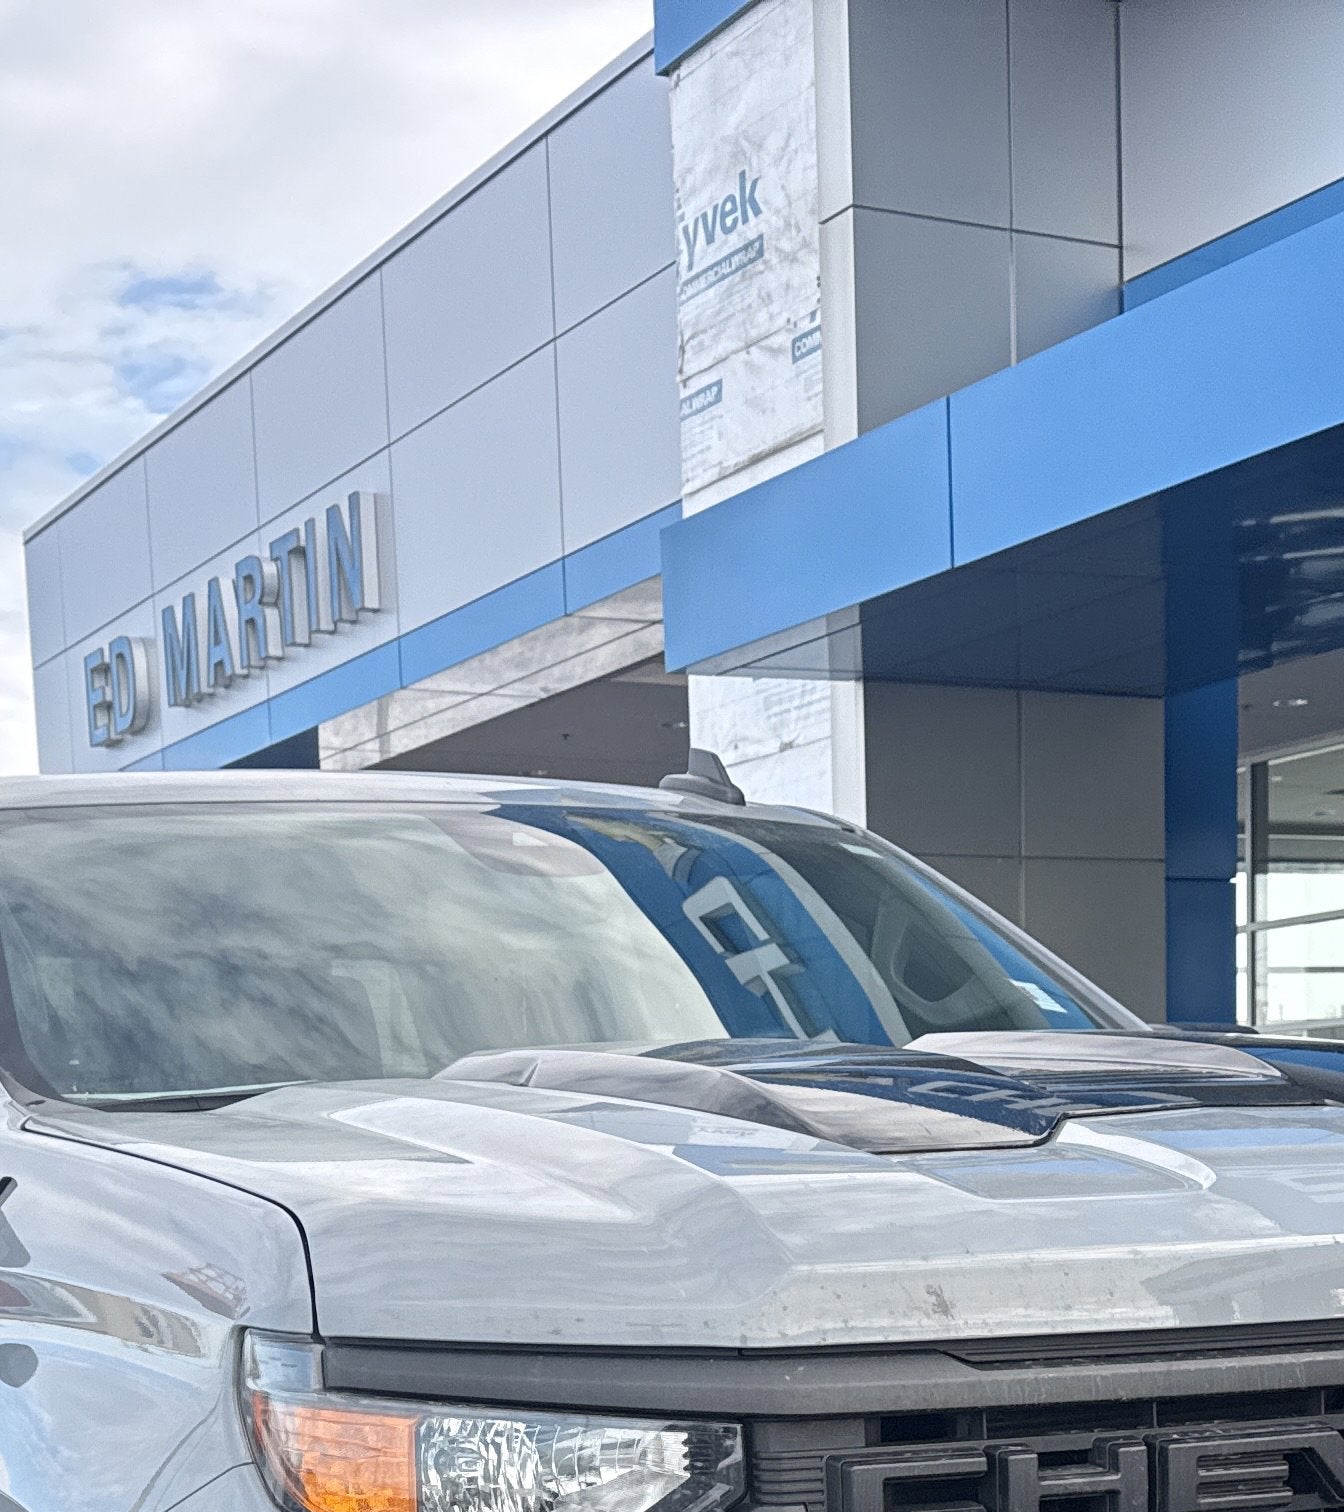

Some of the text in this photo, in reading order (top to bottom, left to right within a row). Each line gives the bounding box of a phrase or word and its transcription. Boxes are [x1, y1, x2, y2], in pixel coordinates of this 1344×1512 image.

[680, 169, 763, 272] yvek
[84, 490, 378, 748] ED MARTIN
